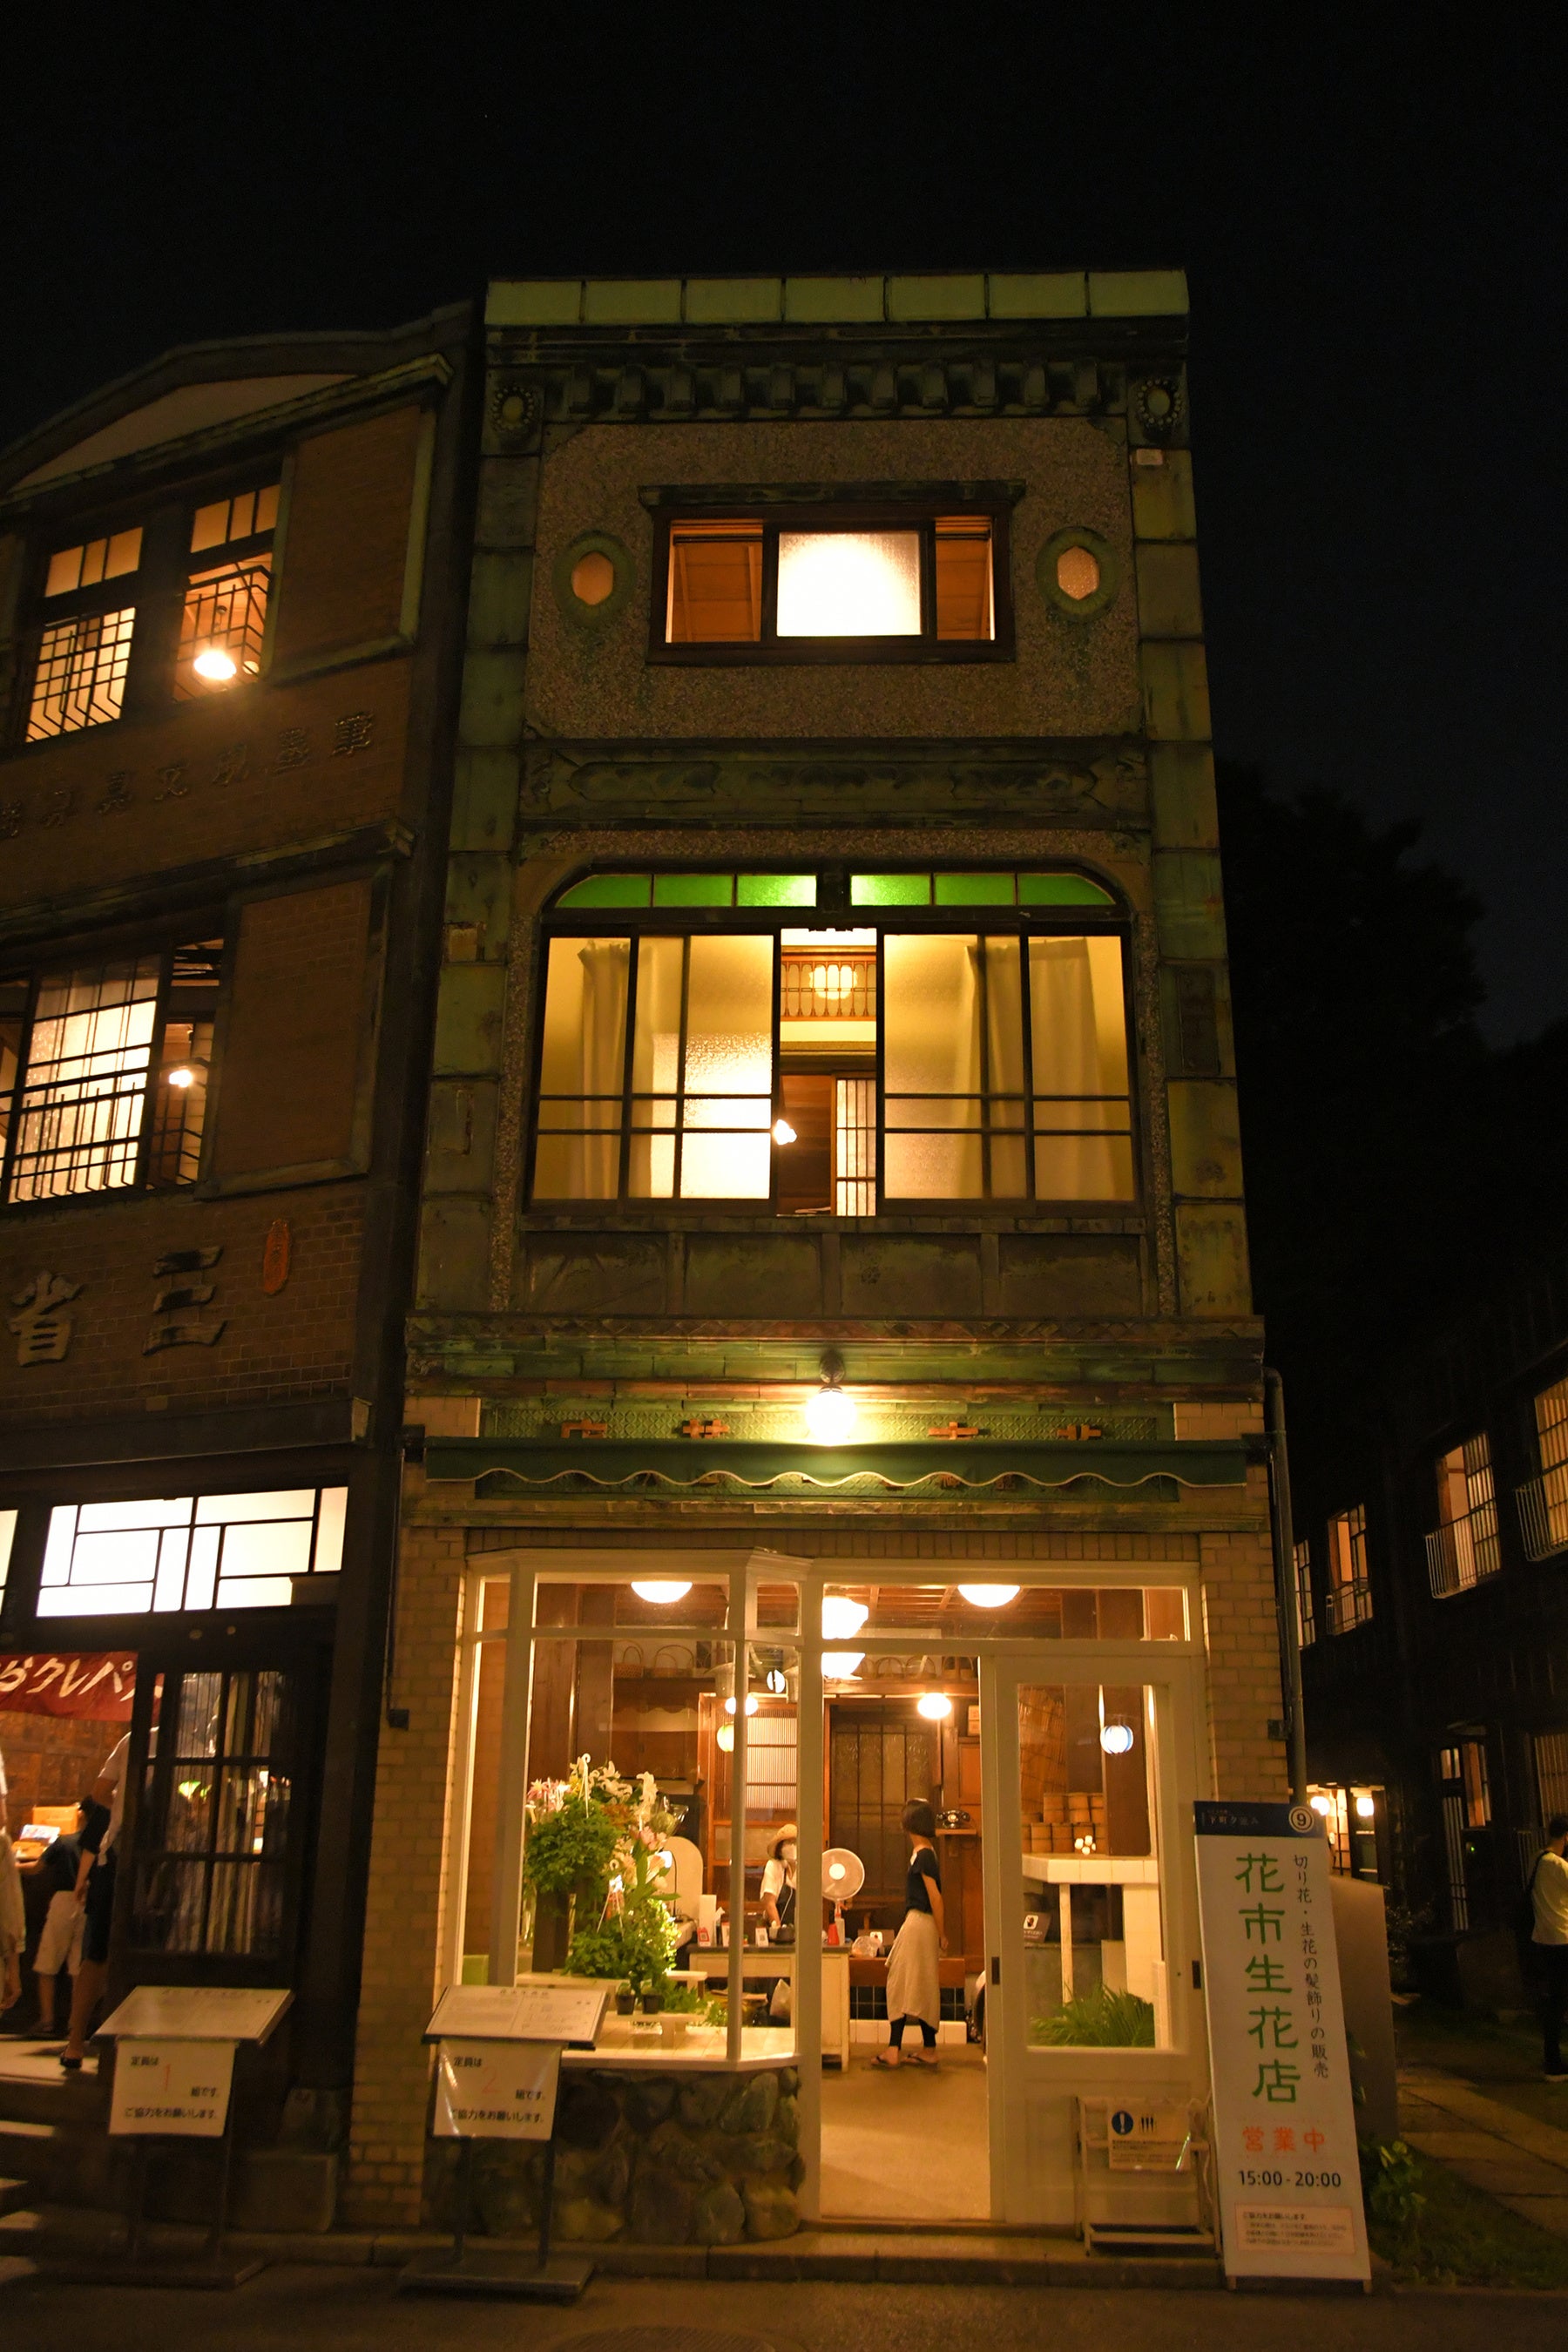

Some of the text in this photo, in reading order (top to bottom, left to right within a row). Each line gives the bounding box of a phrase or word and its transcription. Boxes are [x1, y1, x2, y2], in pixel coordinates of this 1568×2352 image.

[1234, 1853, 1301, 2103] 花市生花店
[1241, 2126, 1325, 2153] 営業中
